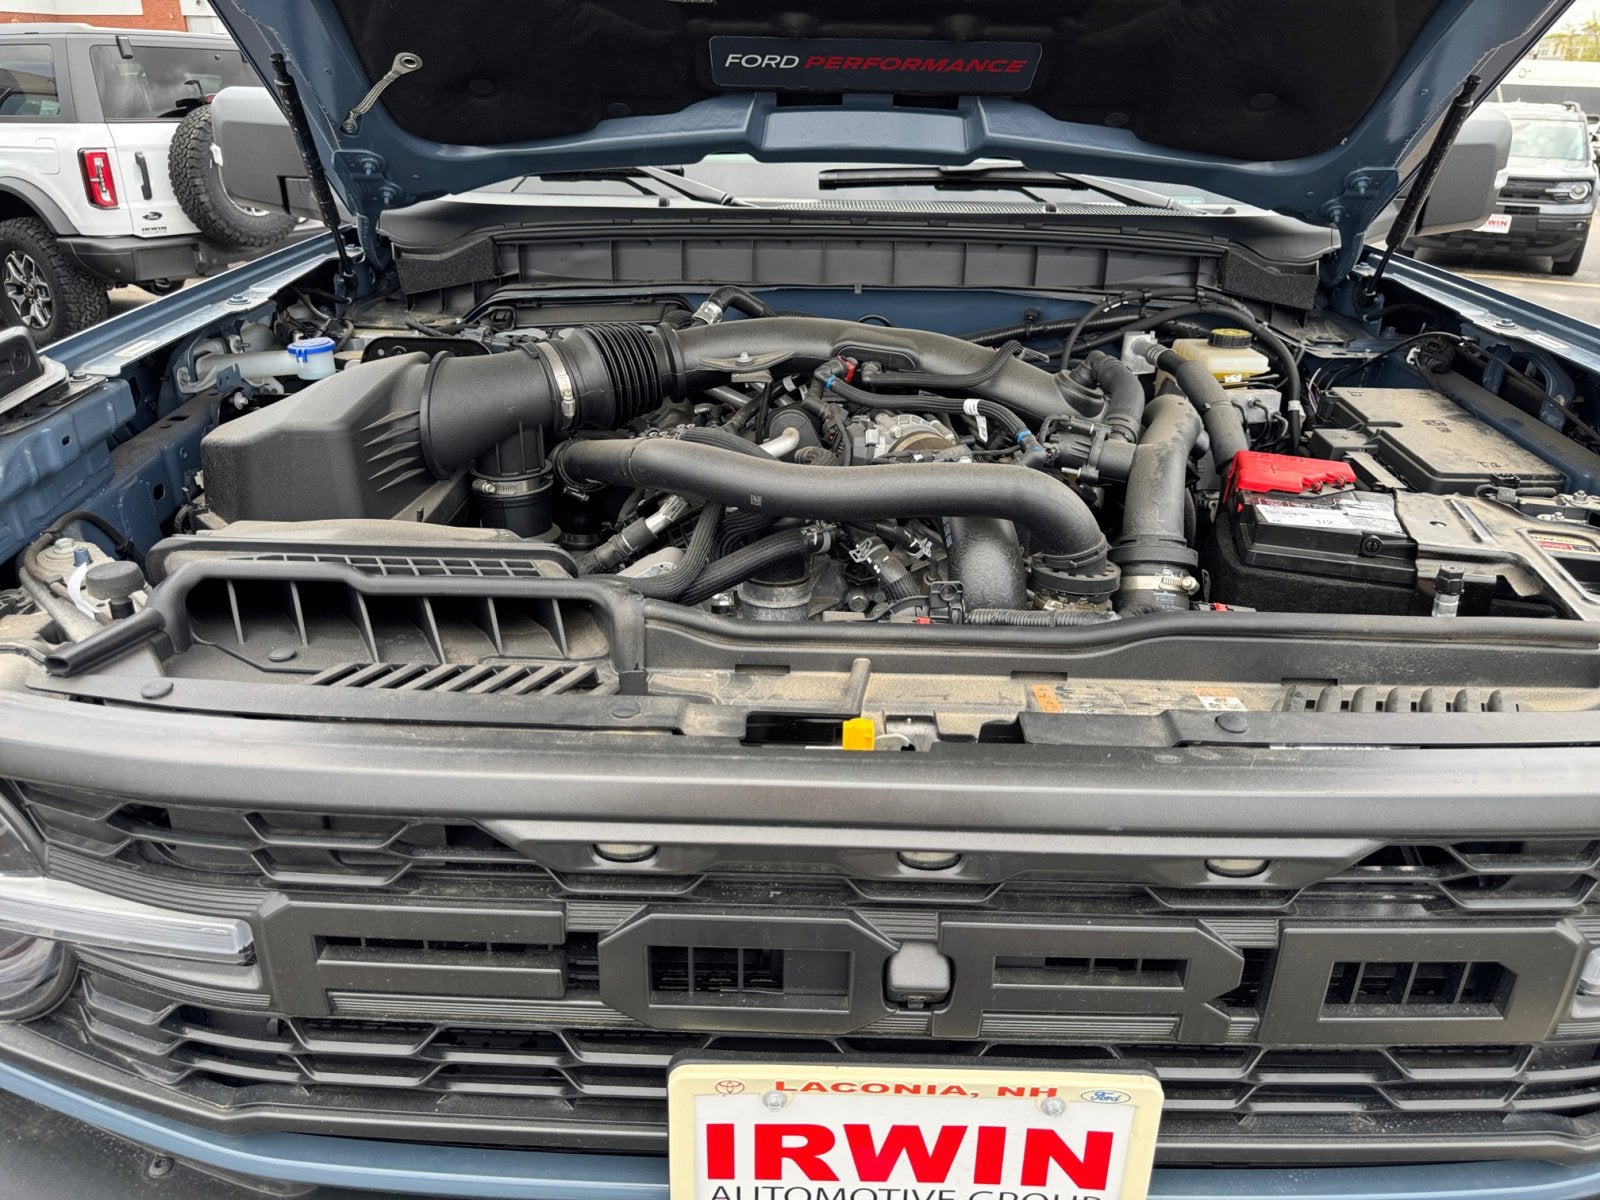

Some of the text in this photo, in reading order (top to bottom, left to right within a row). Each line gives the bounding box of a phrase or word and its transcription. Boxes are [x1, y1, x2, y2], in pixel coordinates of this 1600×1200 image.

[724, 53, 1029, 74] FORD PERFORMANCE
[258, 892, 1585, 1046] FORD
[775, 1081, 1058, 1098] LACONIA, NH
[1087, 1090, 1124, 1104] Ford
[706, 1123, 1114, 1191] IRWIN
